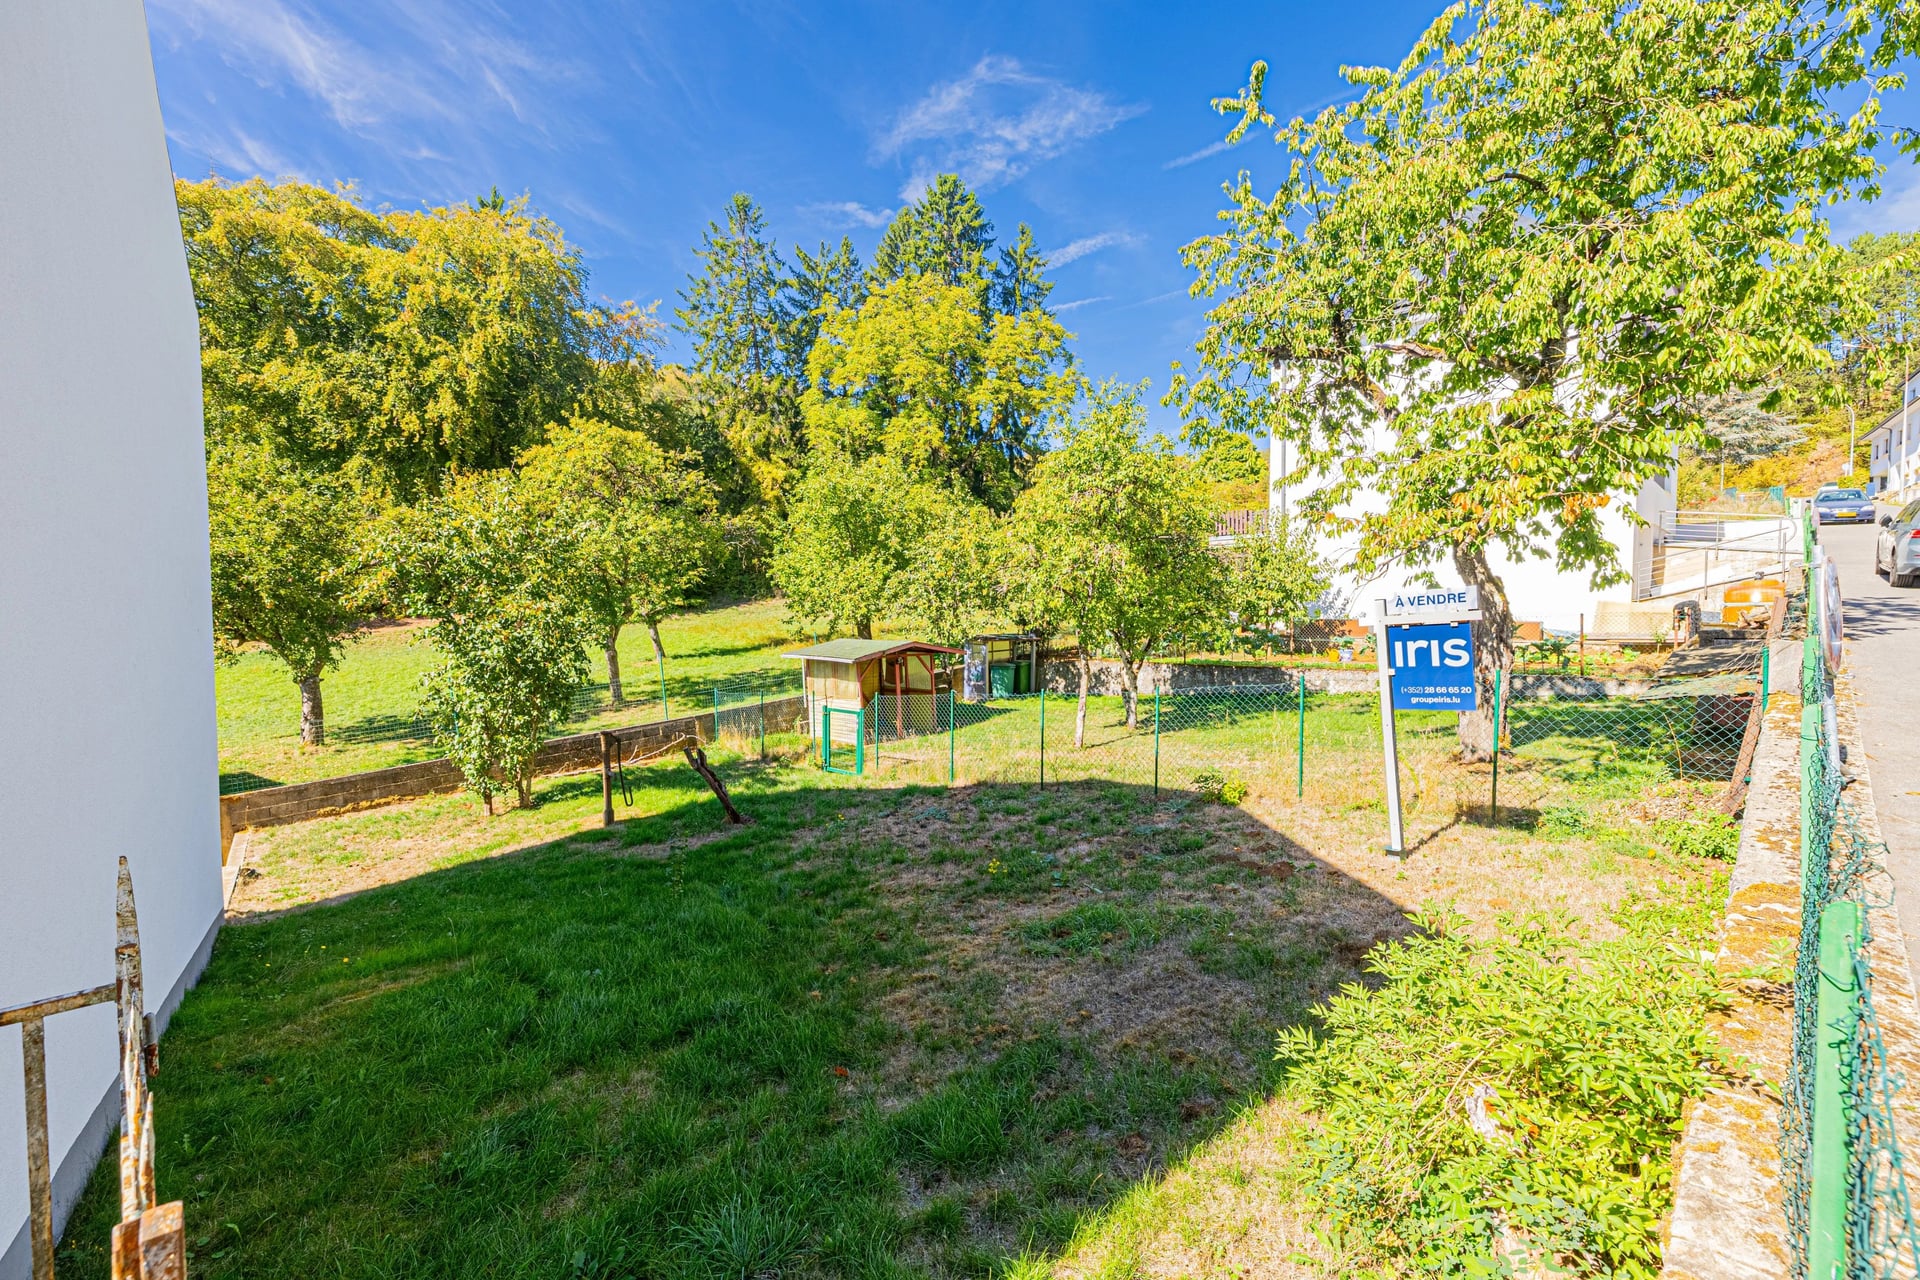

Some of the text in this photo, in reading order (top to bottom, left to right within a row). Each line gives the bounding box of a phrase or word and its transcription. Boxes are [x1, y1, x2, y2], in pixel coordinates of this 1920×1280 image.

[1395, 592, 1467, 608] À VENDRE
[1400, 686, 1472, 694] (+352) 28 66 65 20
[1411, 696, 1461, 704] groupeiris.lu
